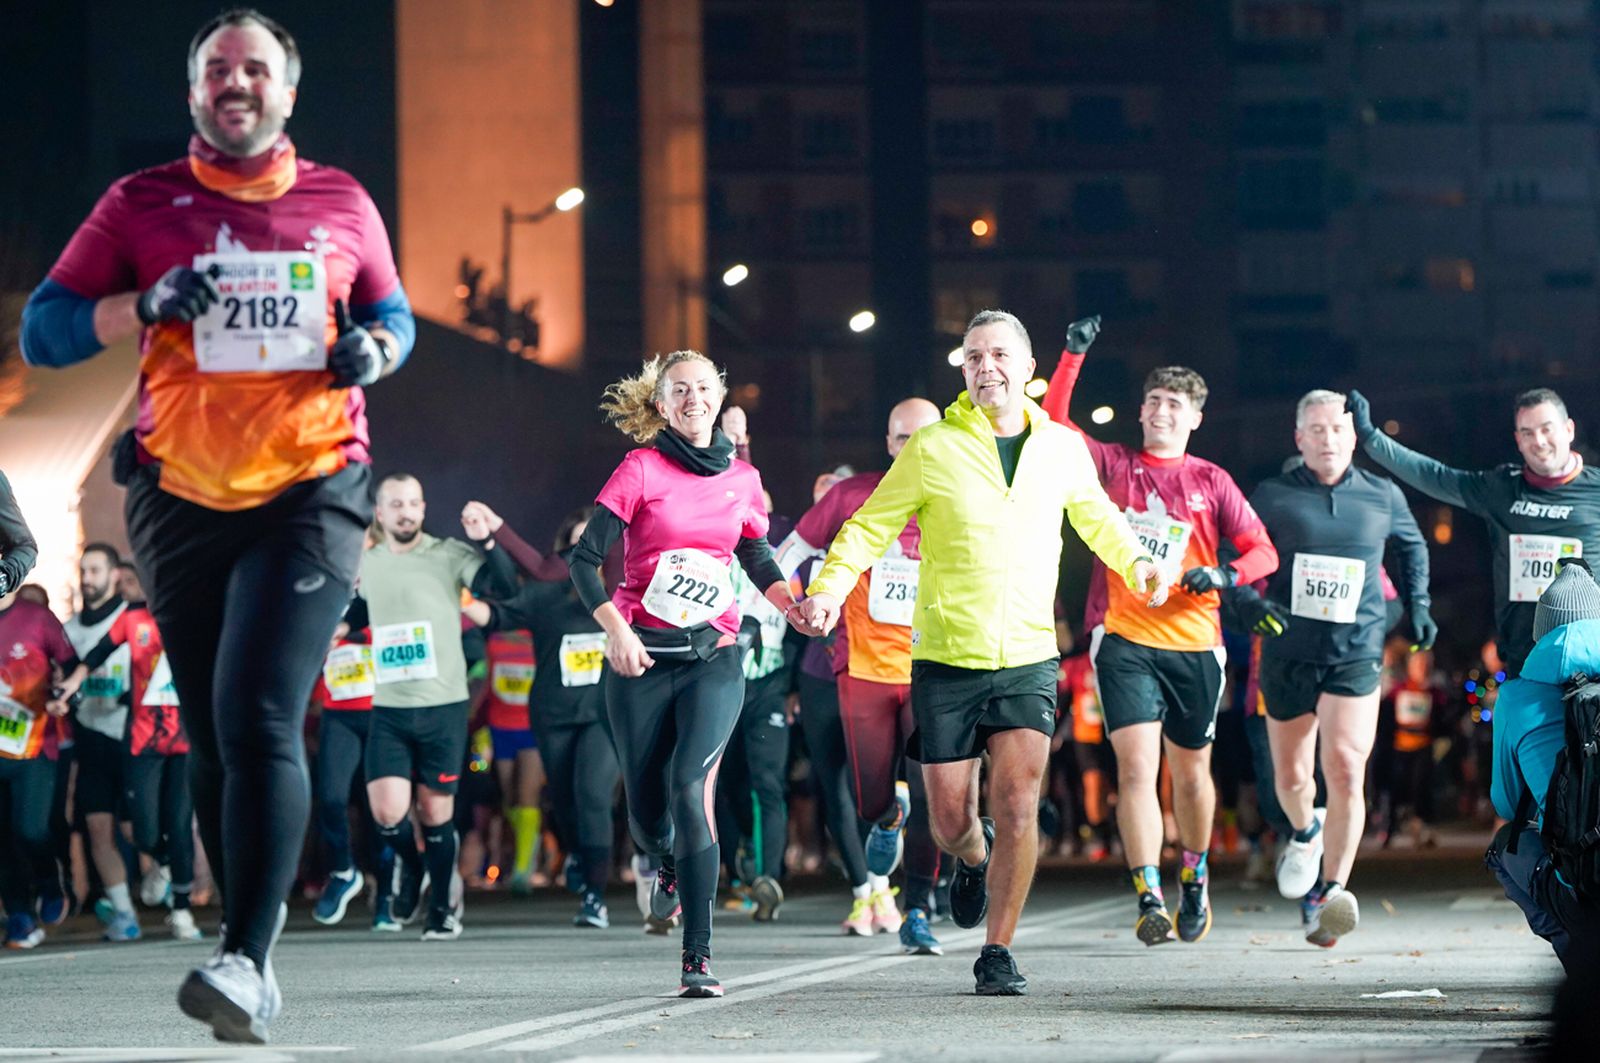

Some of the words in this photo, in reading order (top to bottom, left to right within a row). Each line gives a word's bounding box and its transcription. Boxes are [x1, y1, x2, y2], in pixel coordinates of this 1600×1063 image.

[224, 296, 299, 329] 2182
[667, 574, 719, 608] 2222
[1305, 578, 1350, 600] 5620
